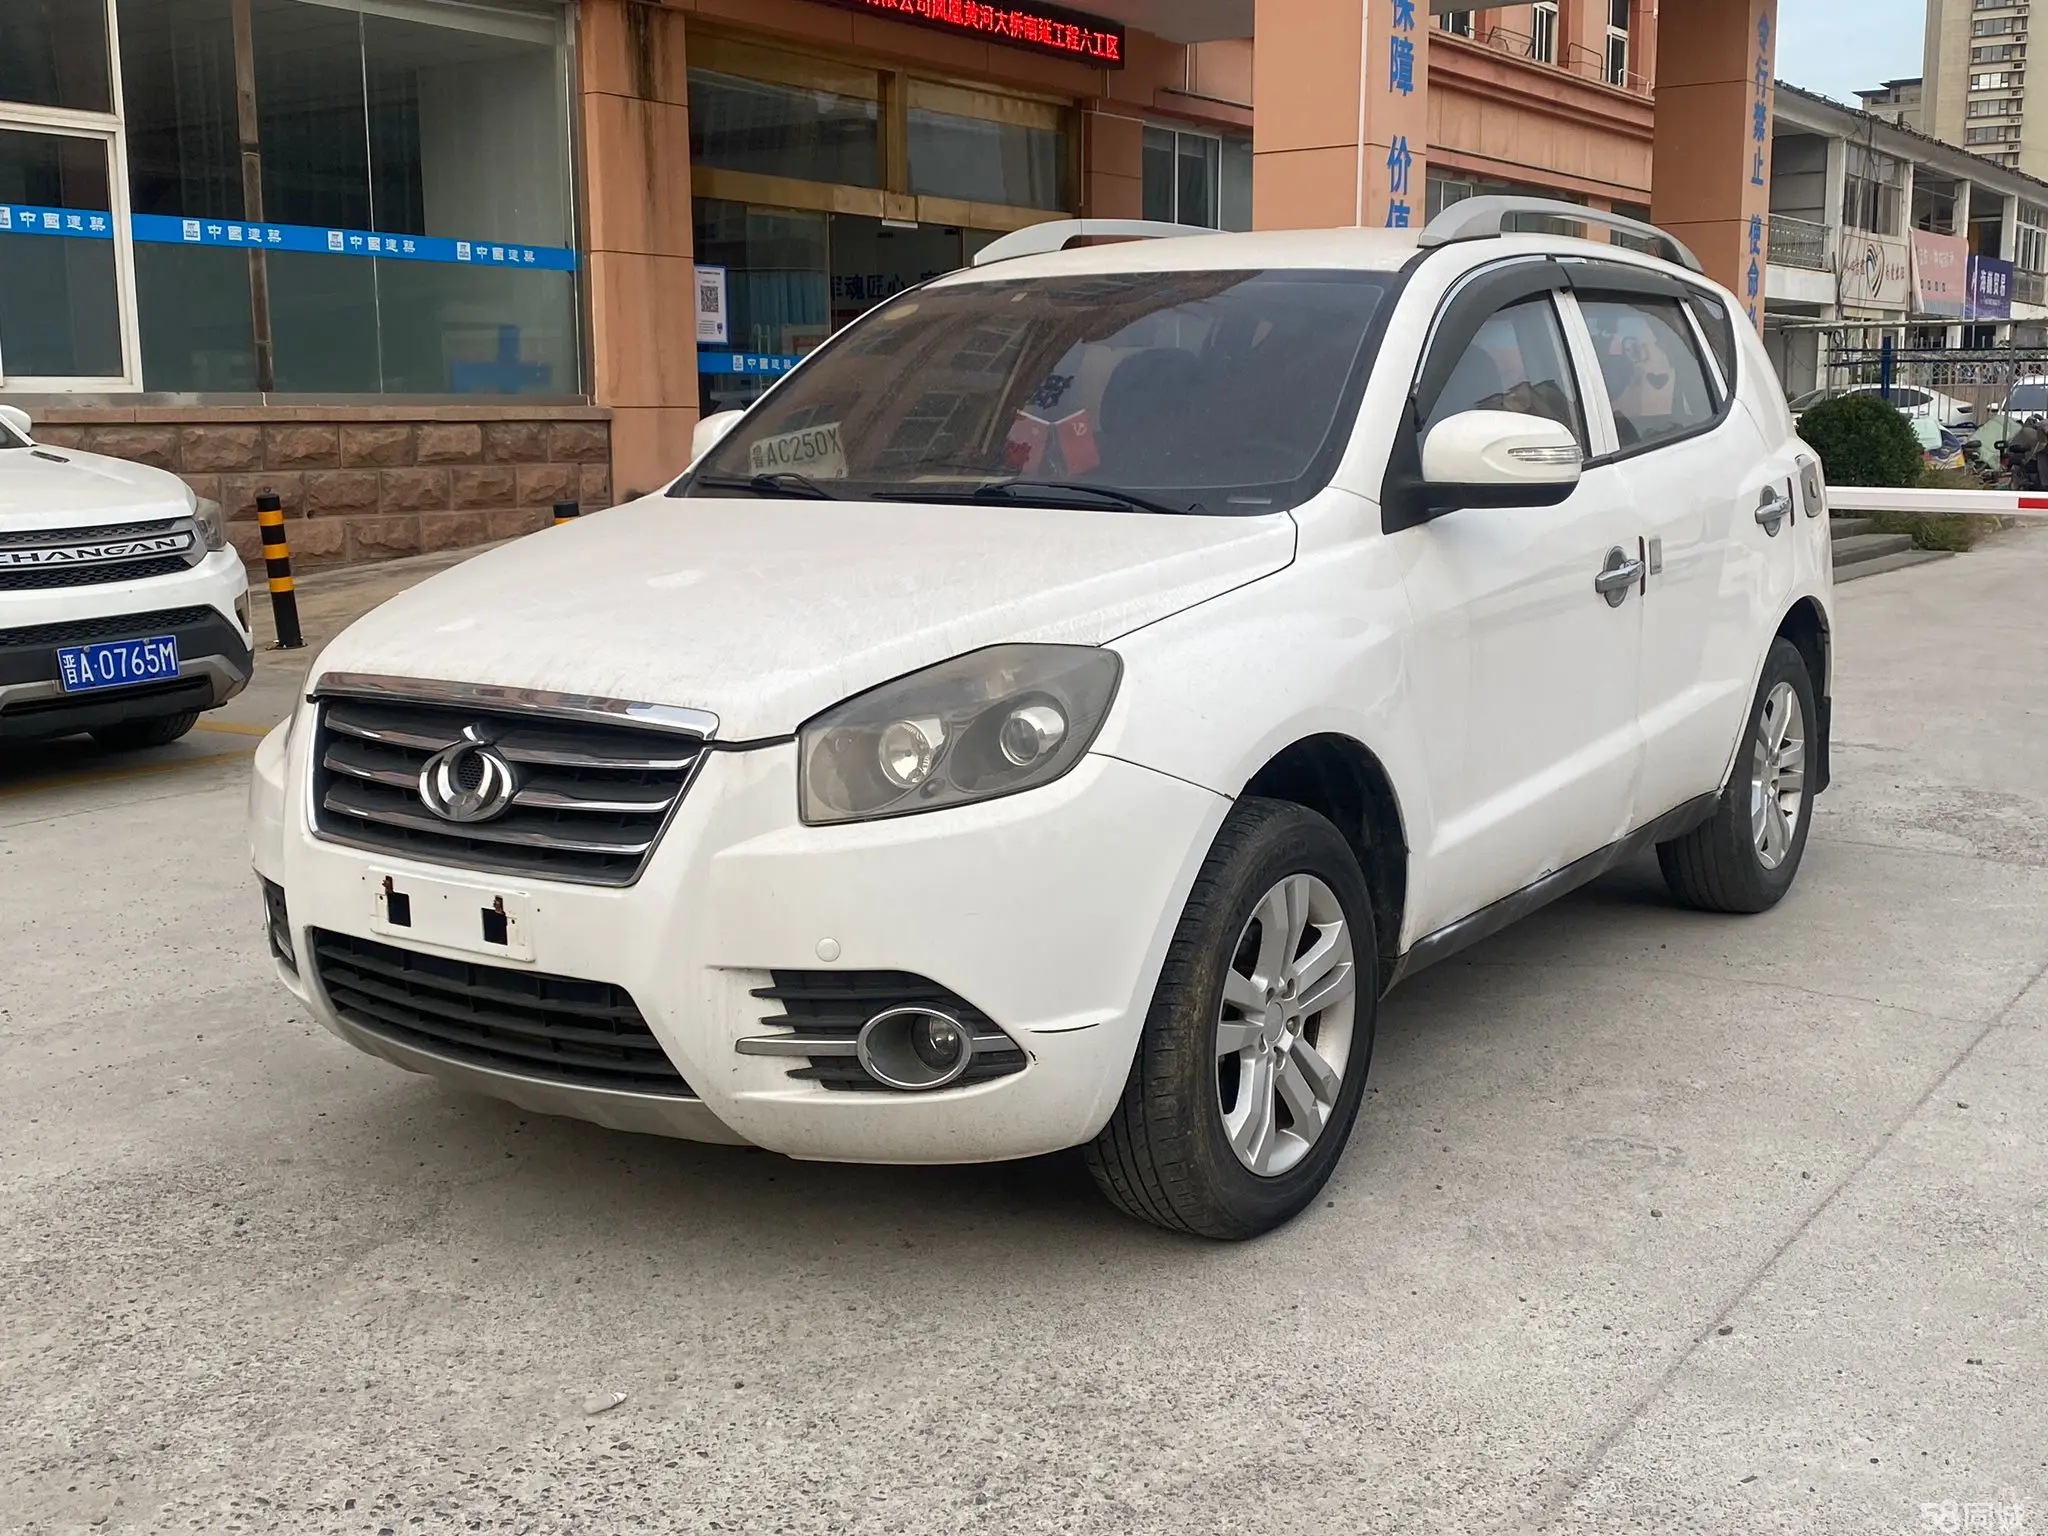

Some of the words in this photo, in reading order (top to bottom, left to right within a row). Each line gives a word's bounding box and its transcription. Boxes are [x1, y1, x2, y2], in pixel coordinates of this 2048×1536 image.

[865, 0, 1120, 60] 公司凤凰黄河大桥南延工程六工区
